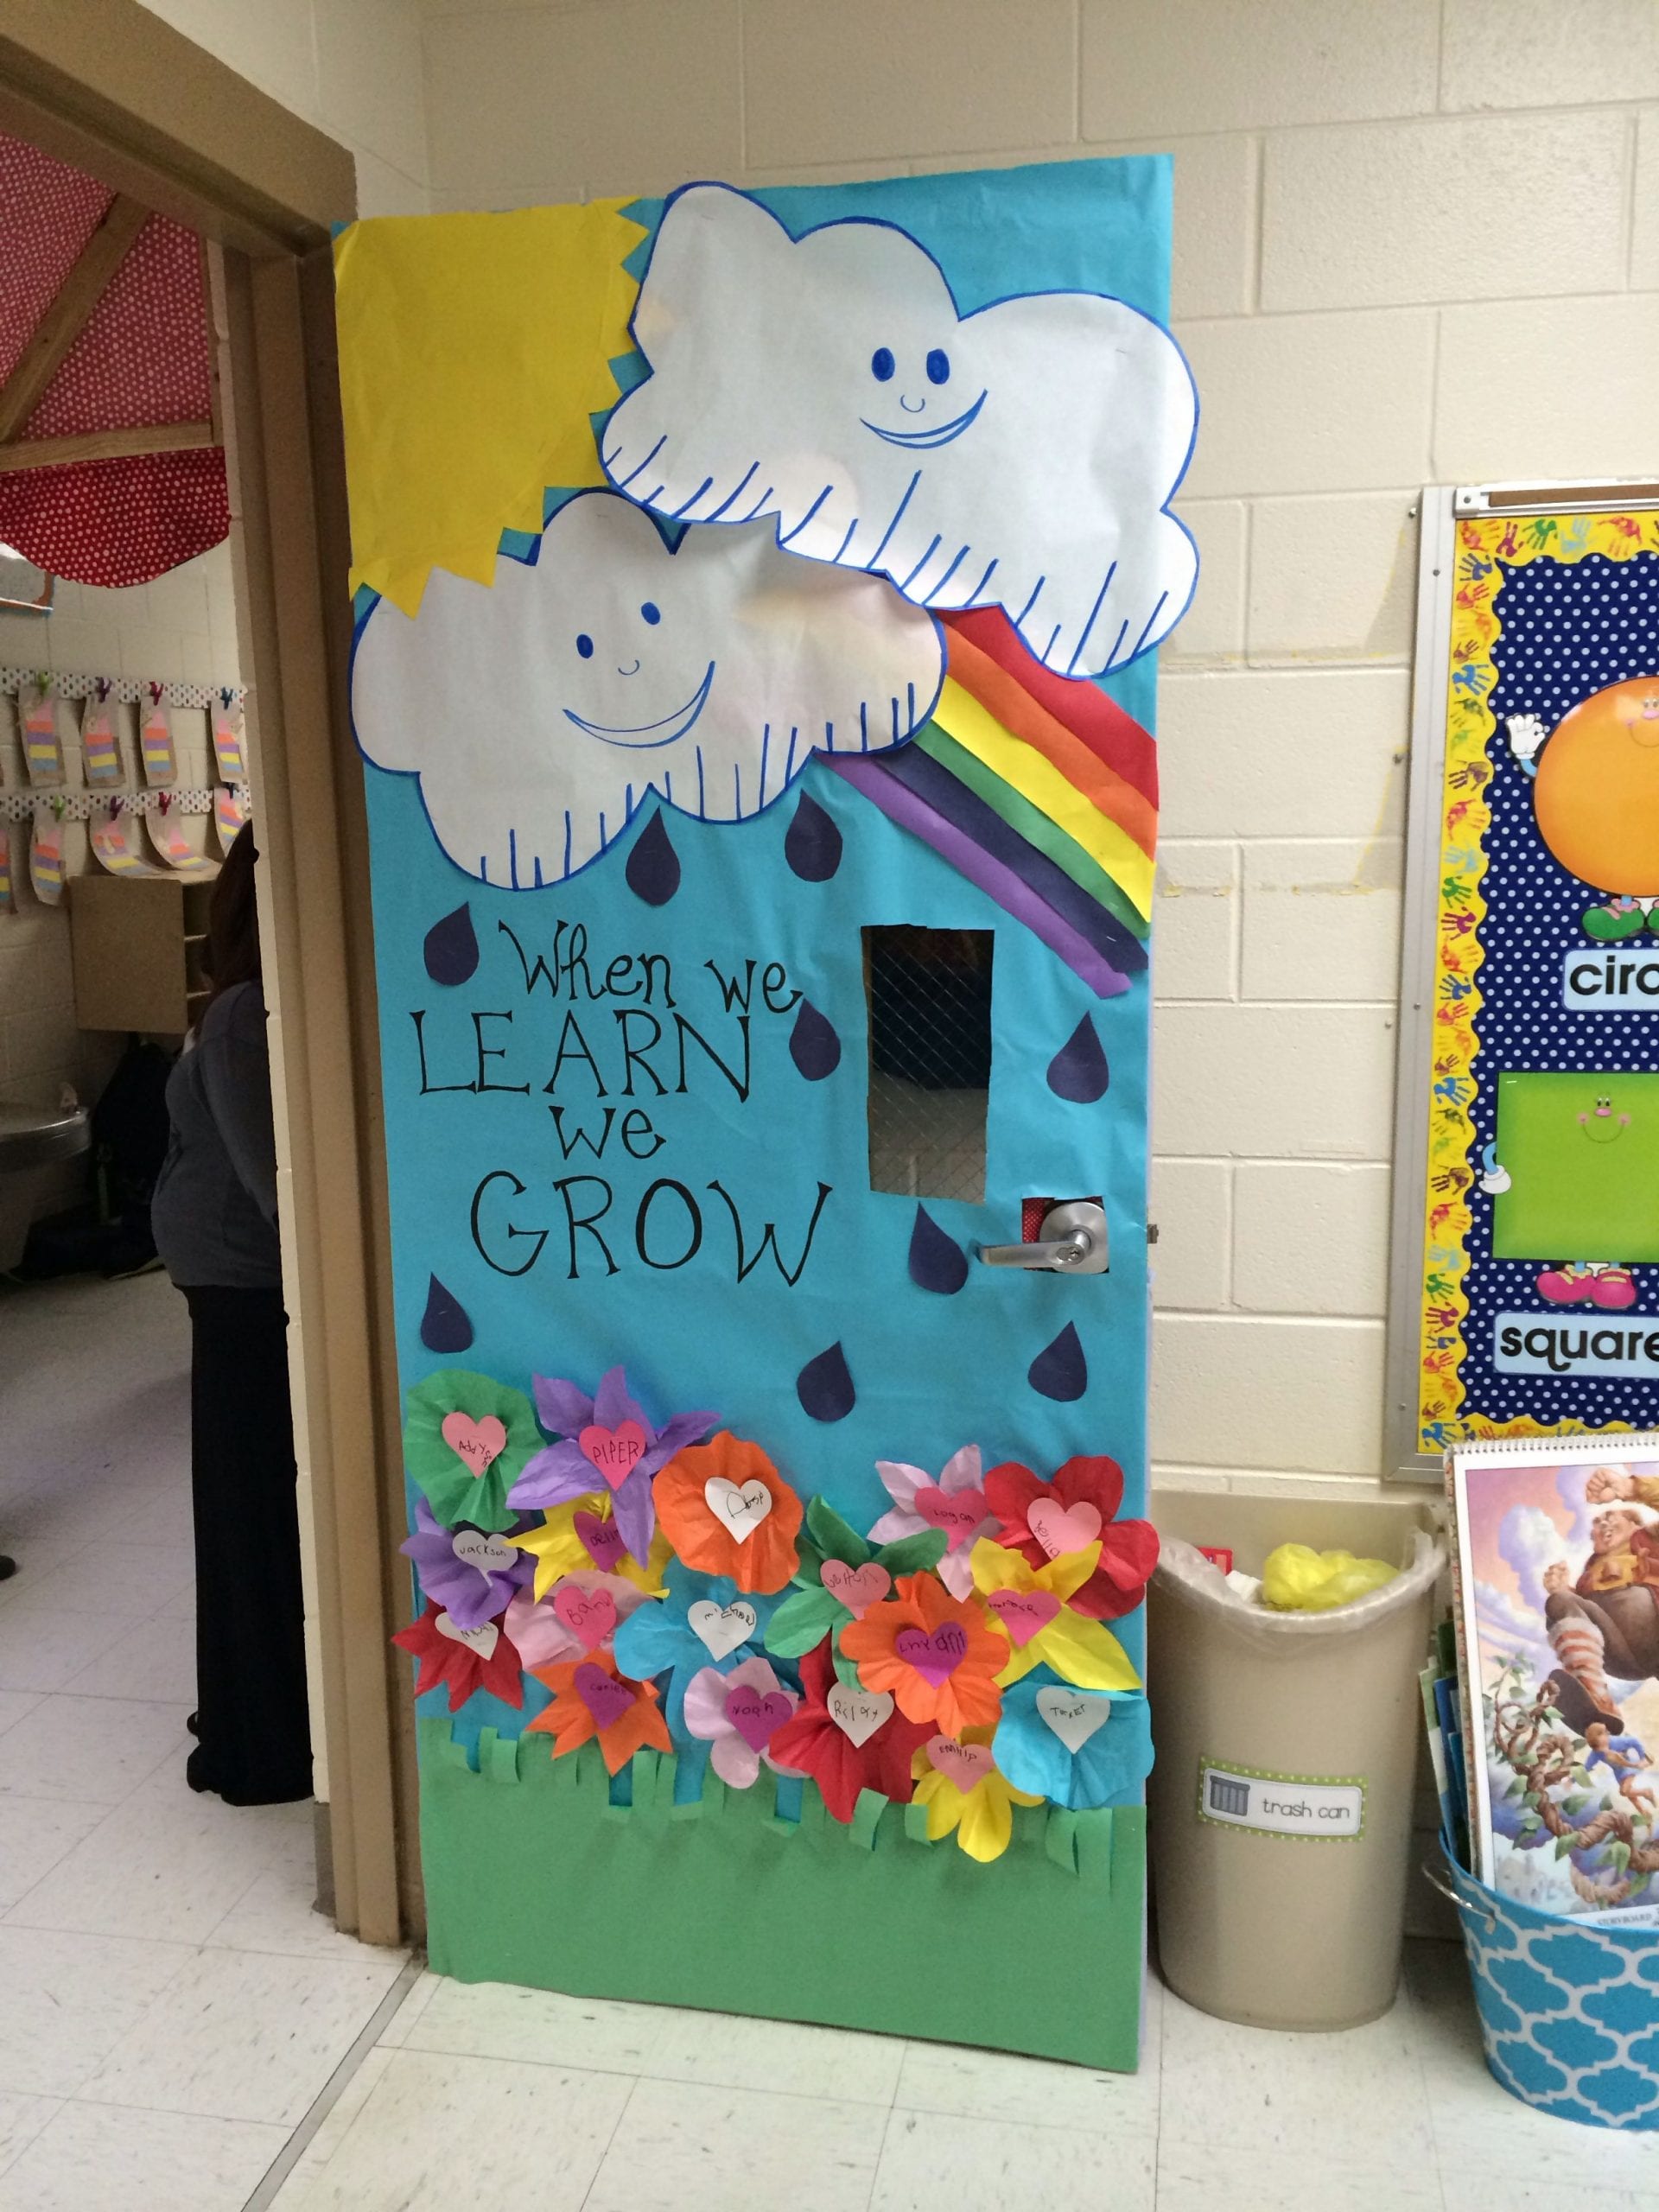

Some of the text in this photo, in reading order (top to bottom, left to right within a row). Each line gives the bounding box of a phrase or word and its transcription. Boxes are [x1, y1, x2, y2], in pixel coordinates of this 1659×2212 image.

[499, 919, 804, 1014] When we
[410, 1009, 751, 1103] LEARN
[549, 1105, 666, 1160] we
[470, 1171, 833, 1287] GROW
[593, 1440, 639, 1465] PIPER
[1262, 1798, 1351, 1820] trash can
